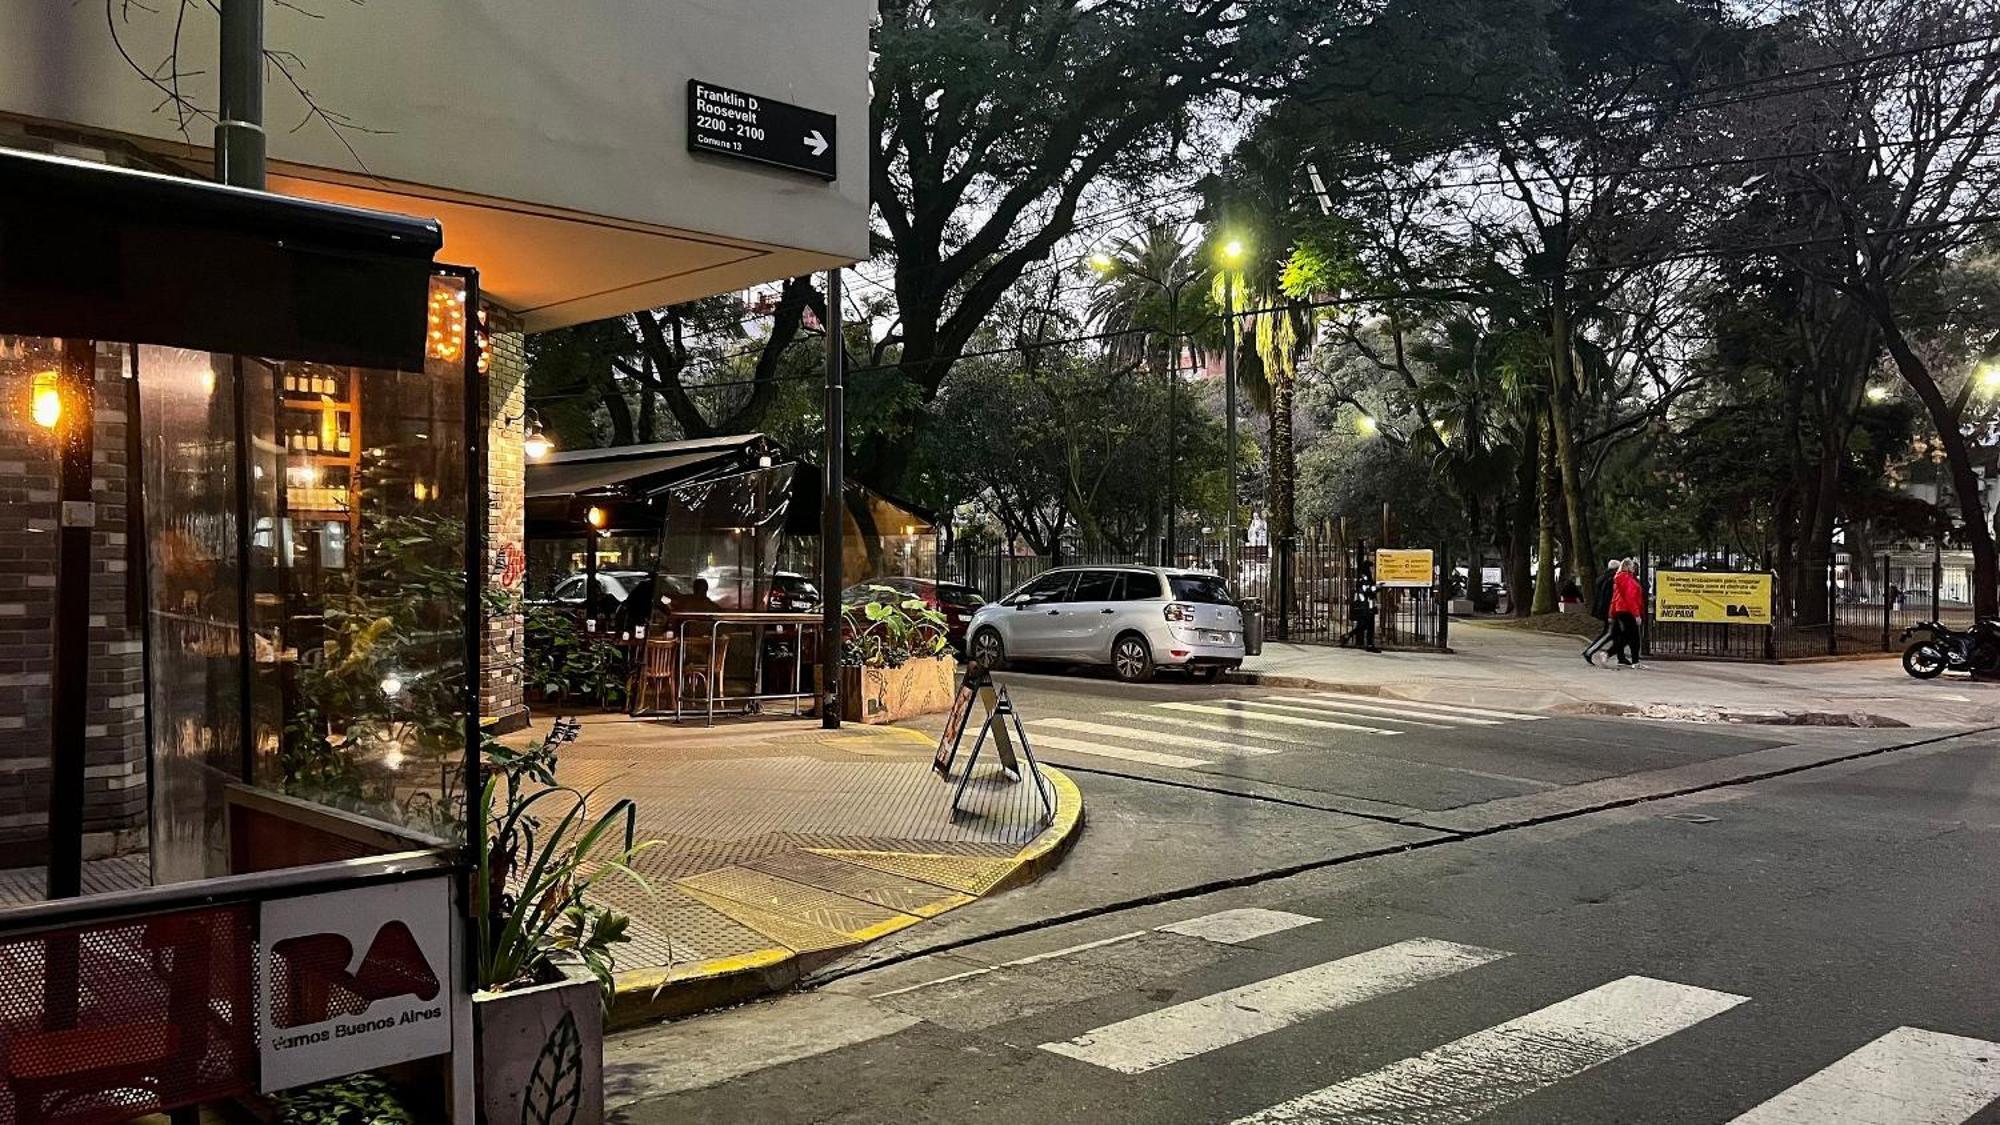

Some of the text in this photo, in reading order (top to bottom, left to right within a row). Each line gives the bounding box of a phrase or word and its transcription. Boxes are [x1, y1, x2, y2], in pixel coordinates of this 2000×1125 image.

[696, 98, 757, 124] Roosevelt
[697, 85, 760, 111] Franklin D.
[697, 115, 726, 132] 2200
[736, 124, 765, 141] 2100
[697, 134, 742, 151] Comuna 13
[272, 1007, 442, 1051] Vamos Buenos Aires
